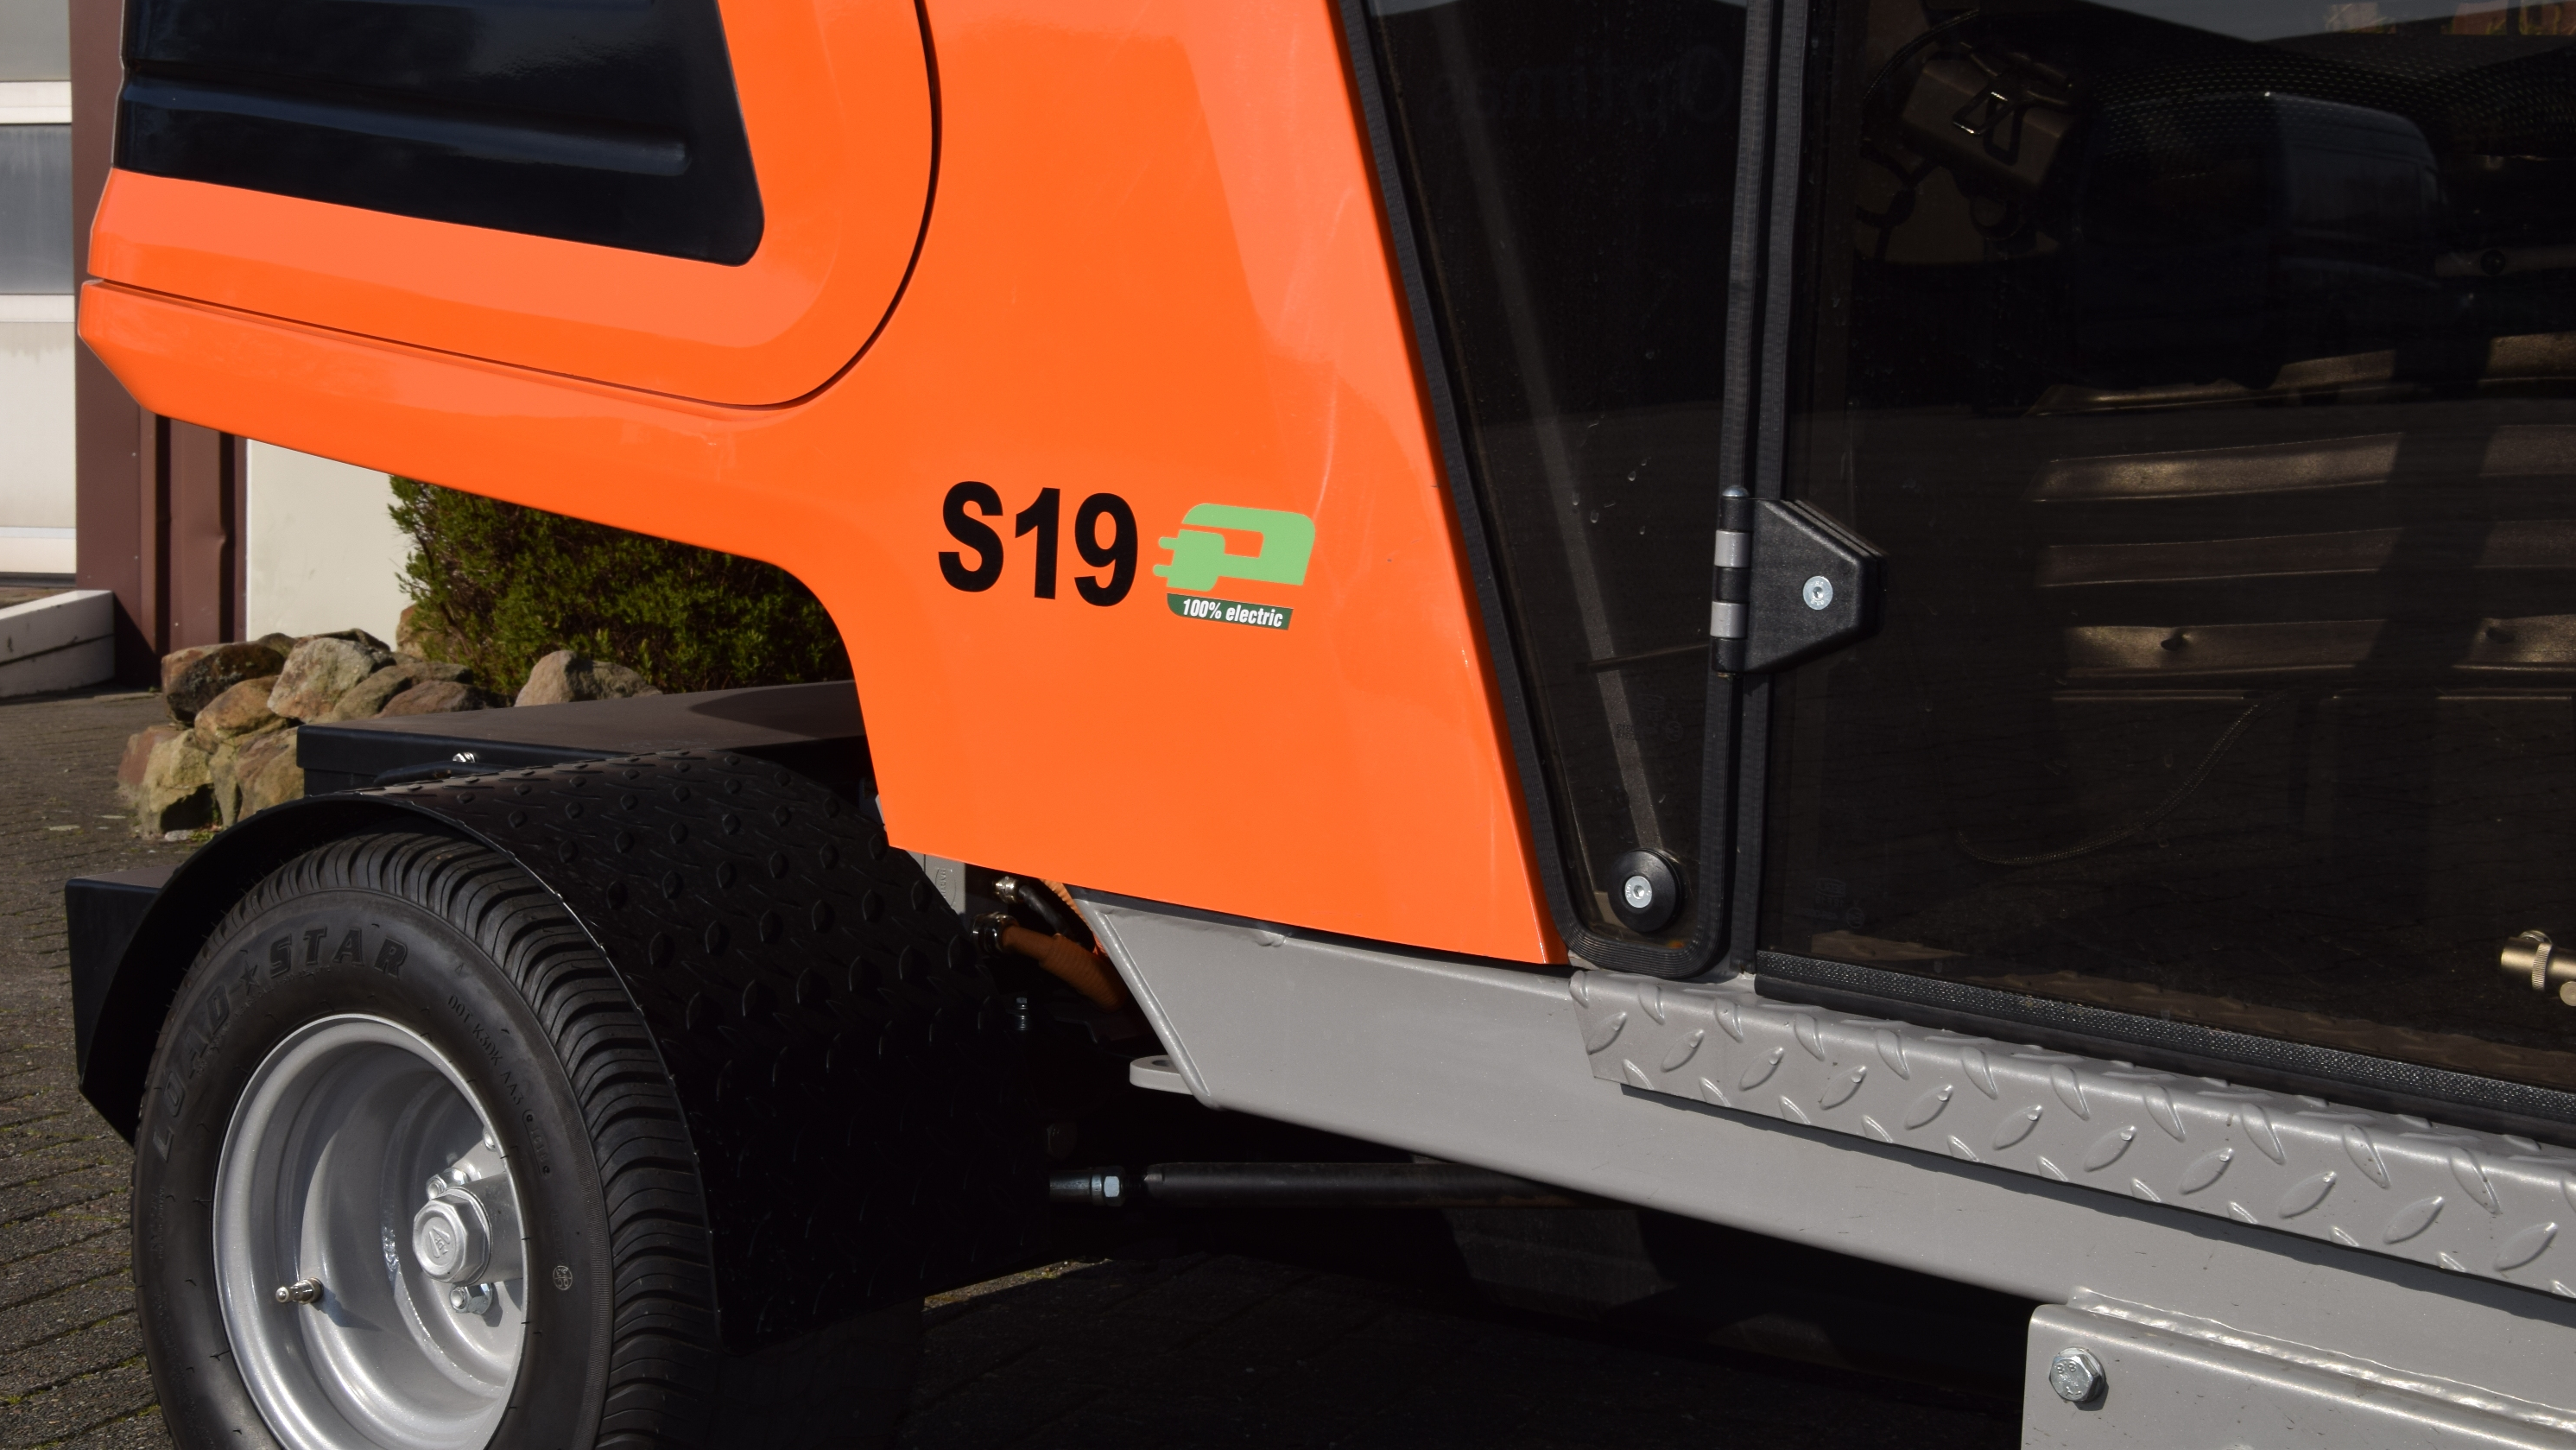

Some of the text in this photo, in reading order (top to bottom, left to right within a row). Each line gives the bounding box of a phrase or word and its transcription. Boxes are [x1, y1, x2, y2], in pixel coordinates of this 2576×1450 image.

[938, 480, 1138, 607] S19
[1183, 598, 1283, 628] 100% electric
[153, 928, 408, 1162] LOAD STAR
[447, 995, 473, 1020] DOT
